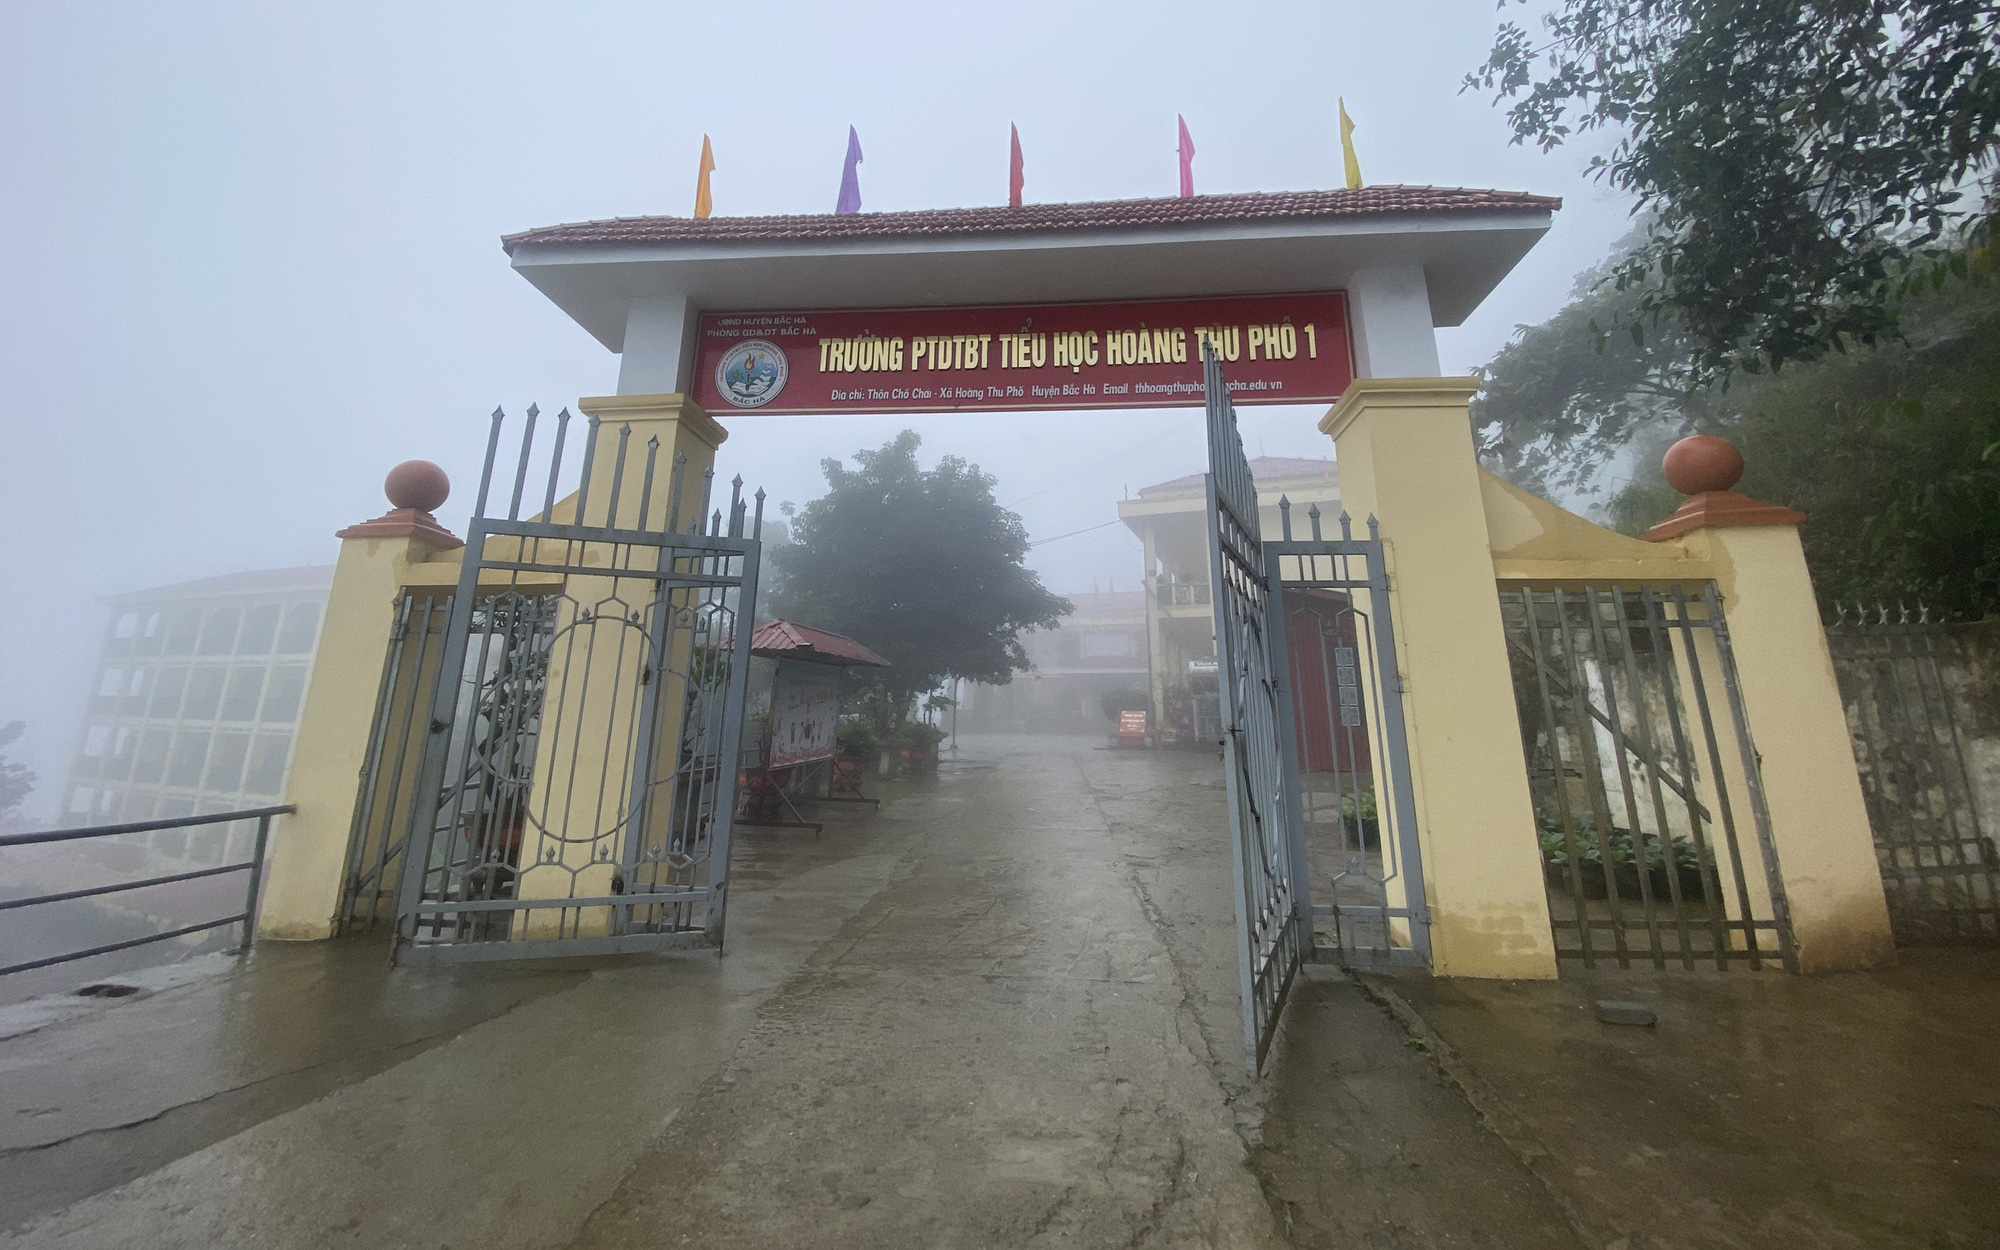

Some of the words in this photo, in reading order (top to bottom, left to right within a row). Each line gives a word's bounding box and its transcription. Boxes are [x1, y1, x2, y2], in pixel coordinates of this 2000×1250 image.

[819, 328, 904, 373] TRƯỜNG
[911, 334, 992, 371] PTDTBT
[999, 317, 1046, 369] TIỂU
[1053, 330, 1099, 374] HỌC
[1106, 321, 1187, 366] HOÀNG
[1194, 325, 1240, 362] THU
[1304, 323, 1317, 359] 1
[867, 388, 889, 400] Thôn
[955, 386, 984, 401] Hoàng
[1031, 384, 1060, 399] Huyện
[1062, 383, 1080, 396] Bắc
